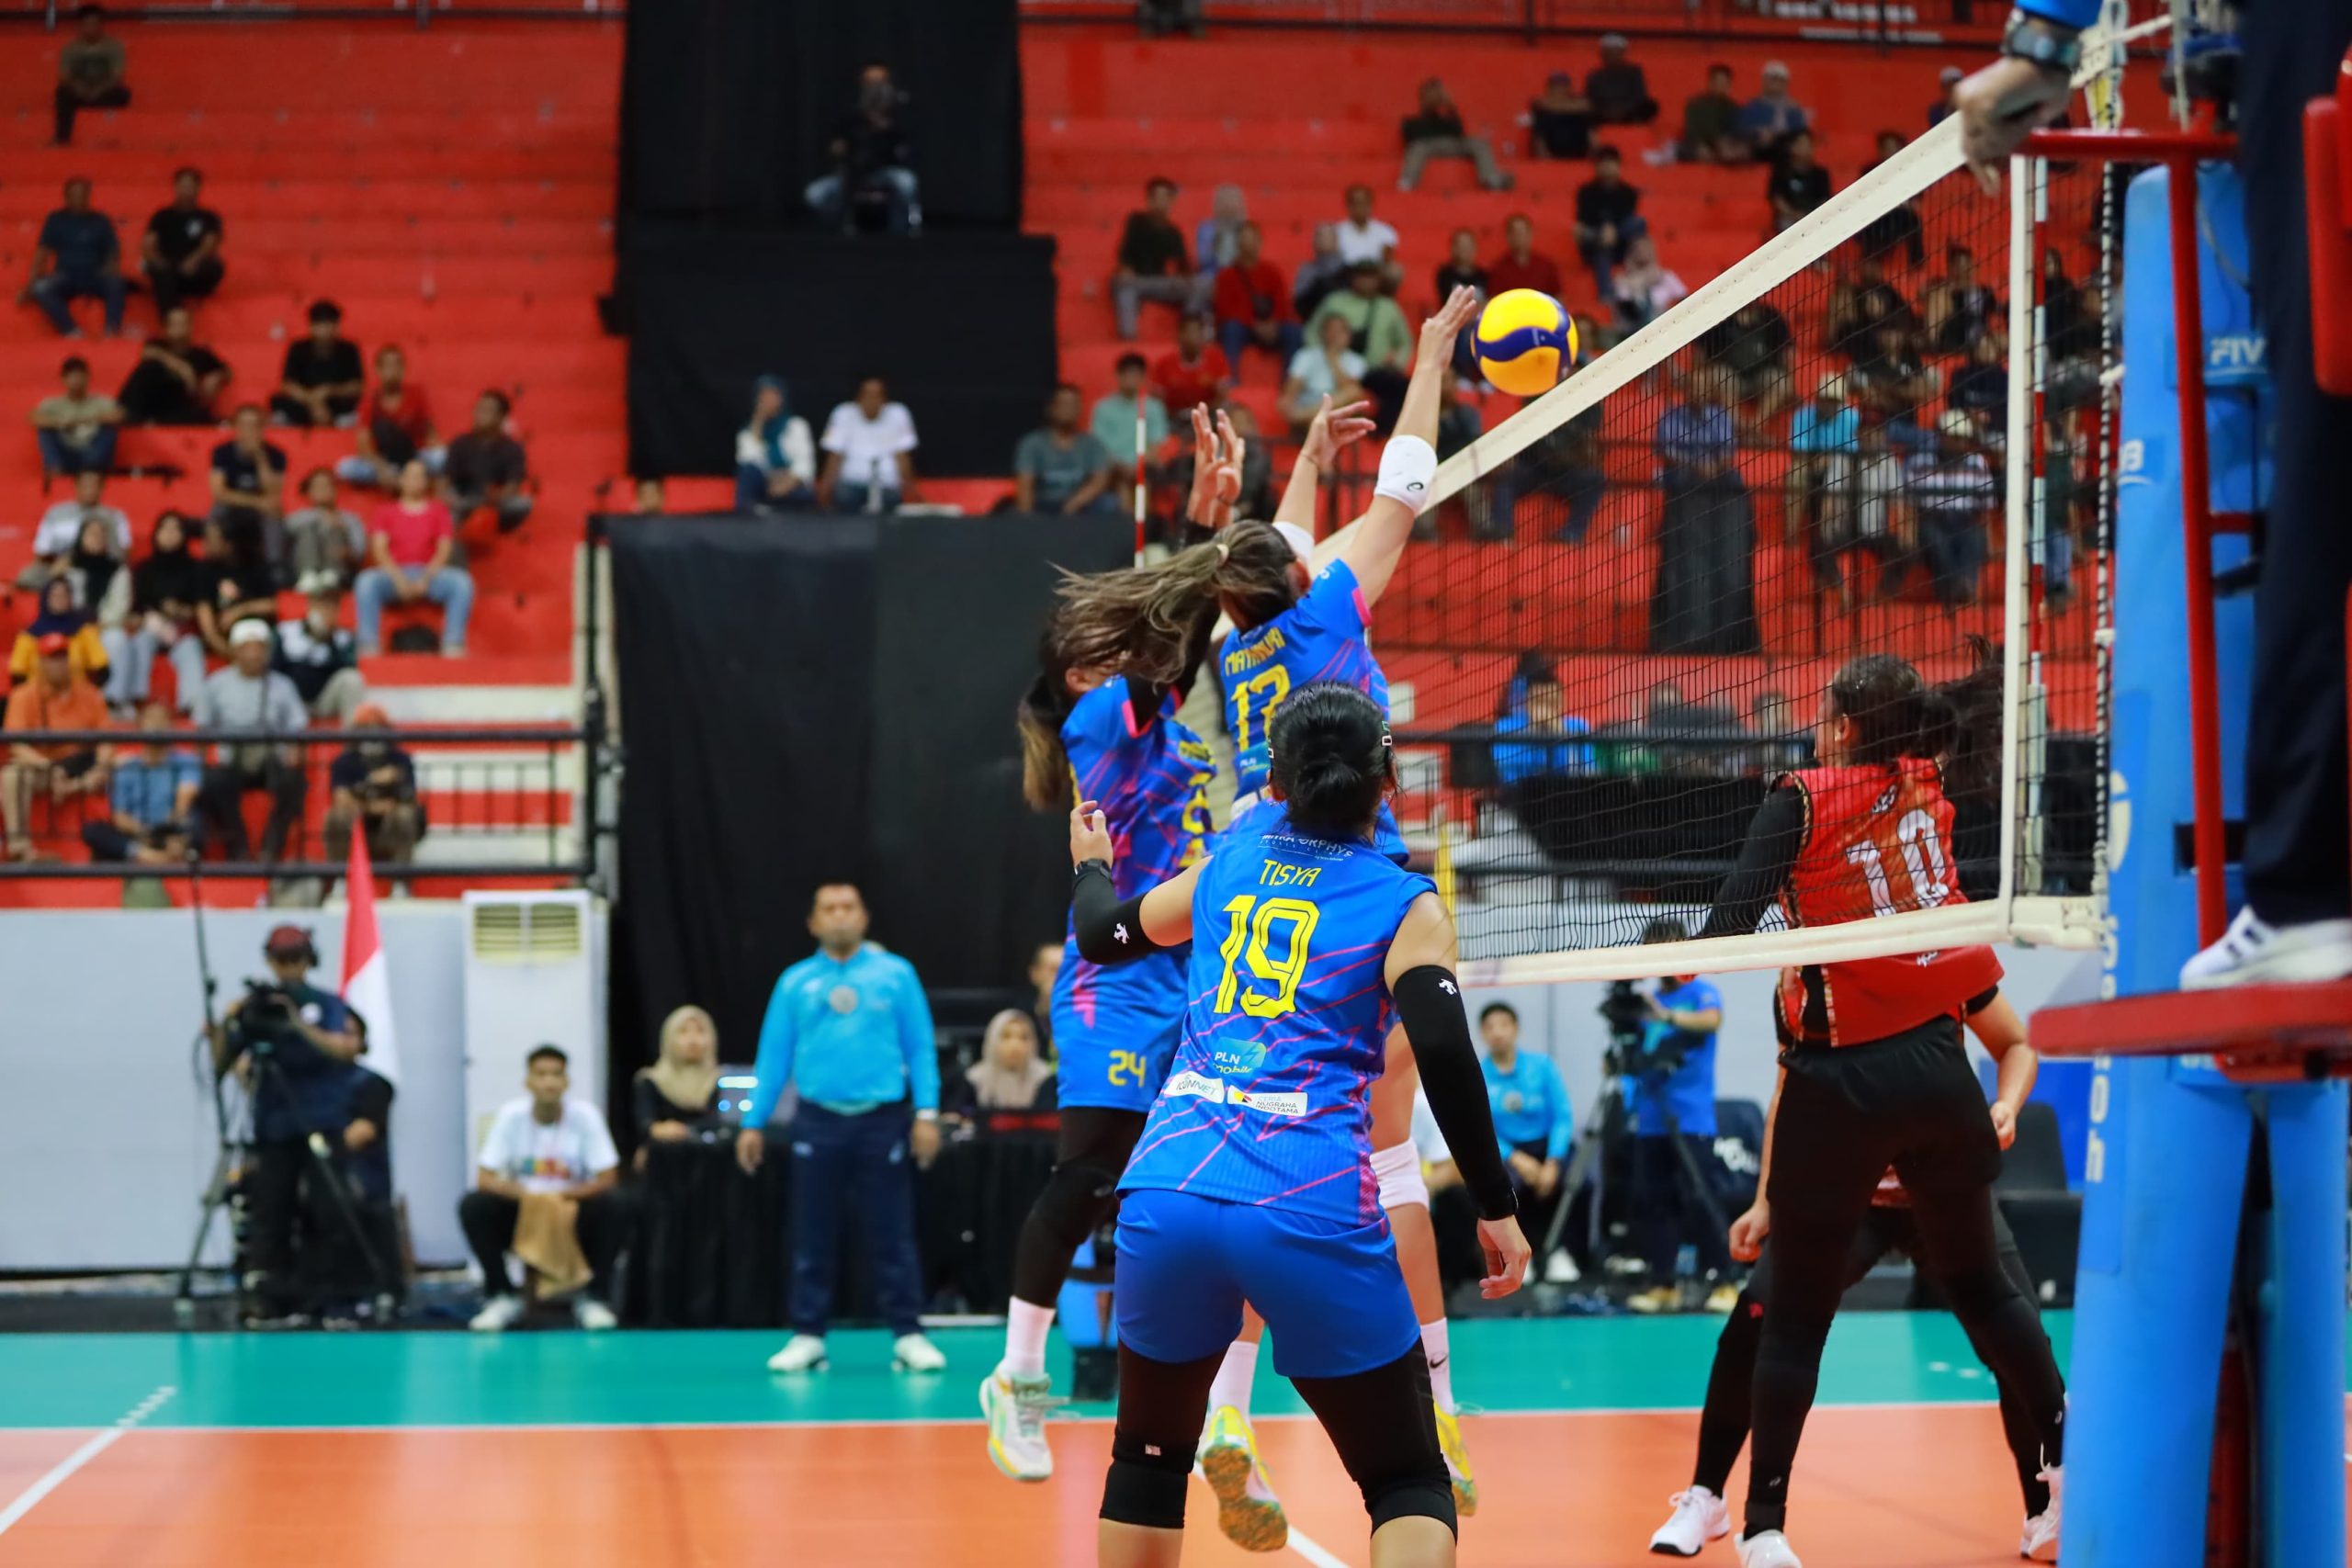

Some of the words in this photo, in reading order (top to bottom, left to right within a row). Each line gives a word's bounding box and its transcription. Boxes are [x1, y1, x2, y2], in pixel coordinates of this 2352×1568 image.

[1259, 858, 1322, 888] TISYA
[1846, 808, 1950, 918] 10
[1213, 894, 1320, 1020] 19
[1108, 1049, 1147, 1089] 24
[1214, 1051, 1240, 1066] PLN
